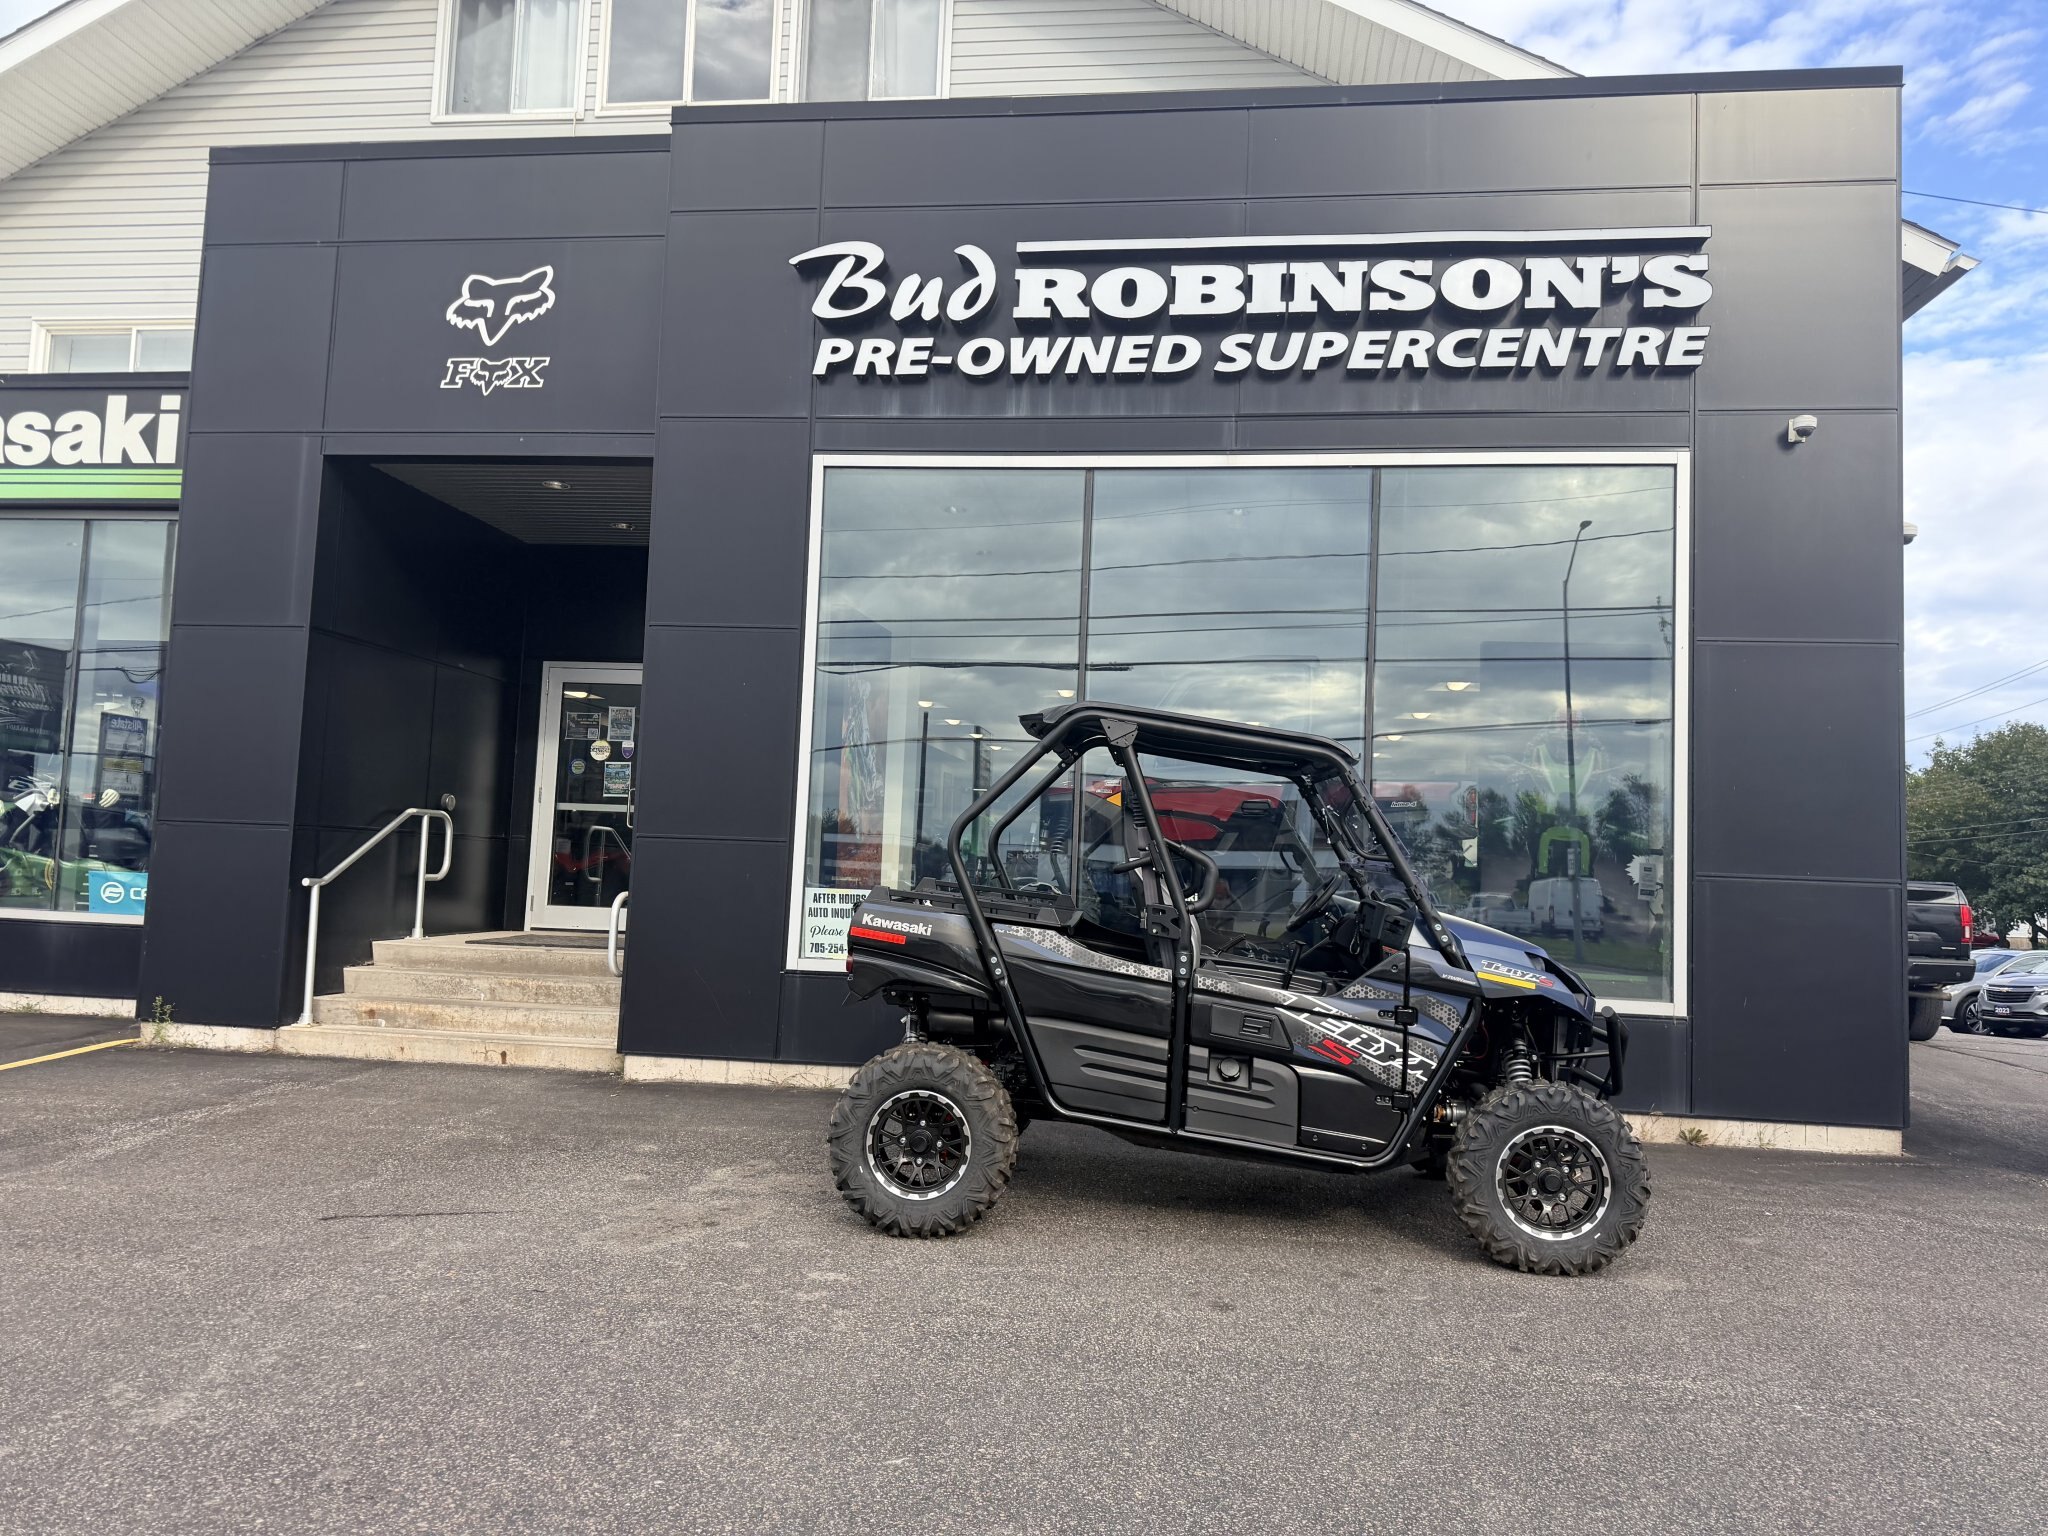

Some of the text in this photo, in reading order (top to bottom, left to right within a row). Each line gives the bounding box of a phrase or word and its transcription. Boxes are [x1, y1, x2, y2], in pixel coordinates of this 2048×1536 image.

[789, 241, 1713, 321] Bud ROBINSON'S
[812, 325, 1711, 376] PRE-OWNED SUPERCENTRE
[0, 394, 181, 466] saki
[813, 893, 836, 904] AFTER
[808, 907, 854, 919] AUTO INQUI
[862, 913, 932, 936] Kawasaki
[810, 925, 844, 937] Please
